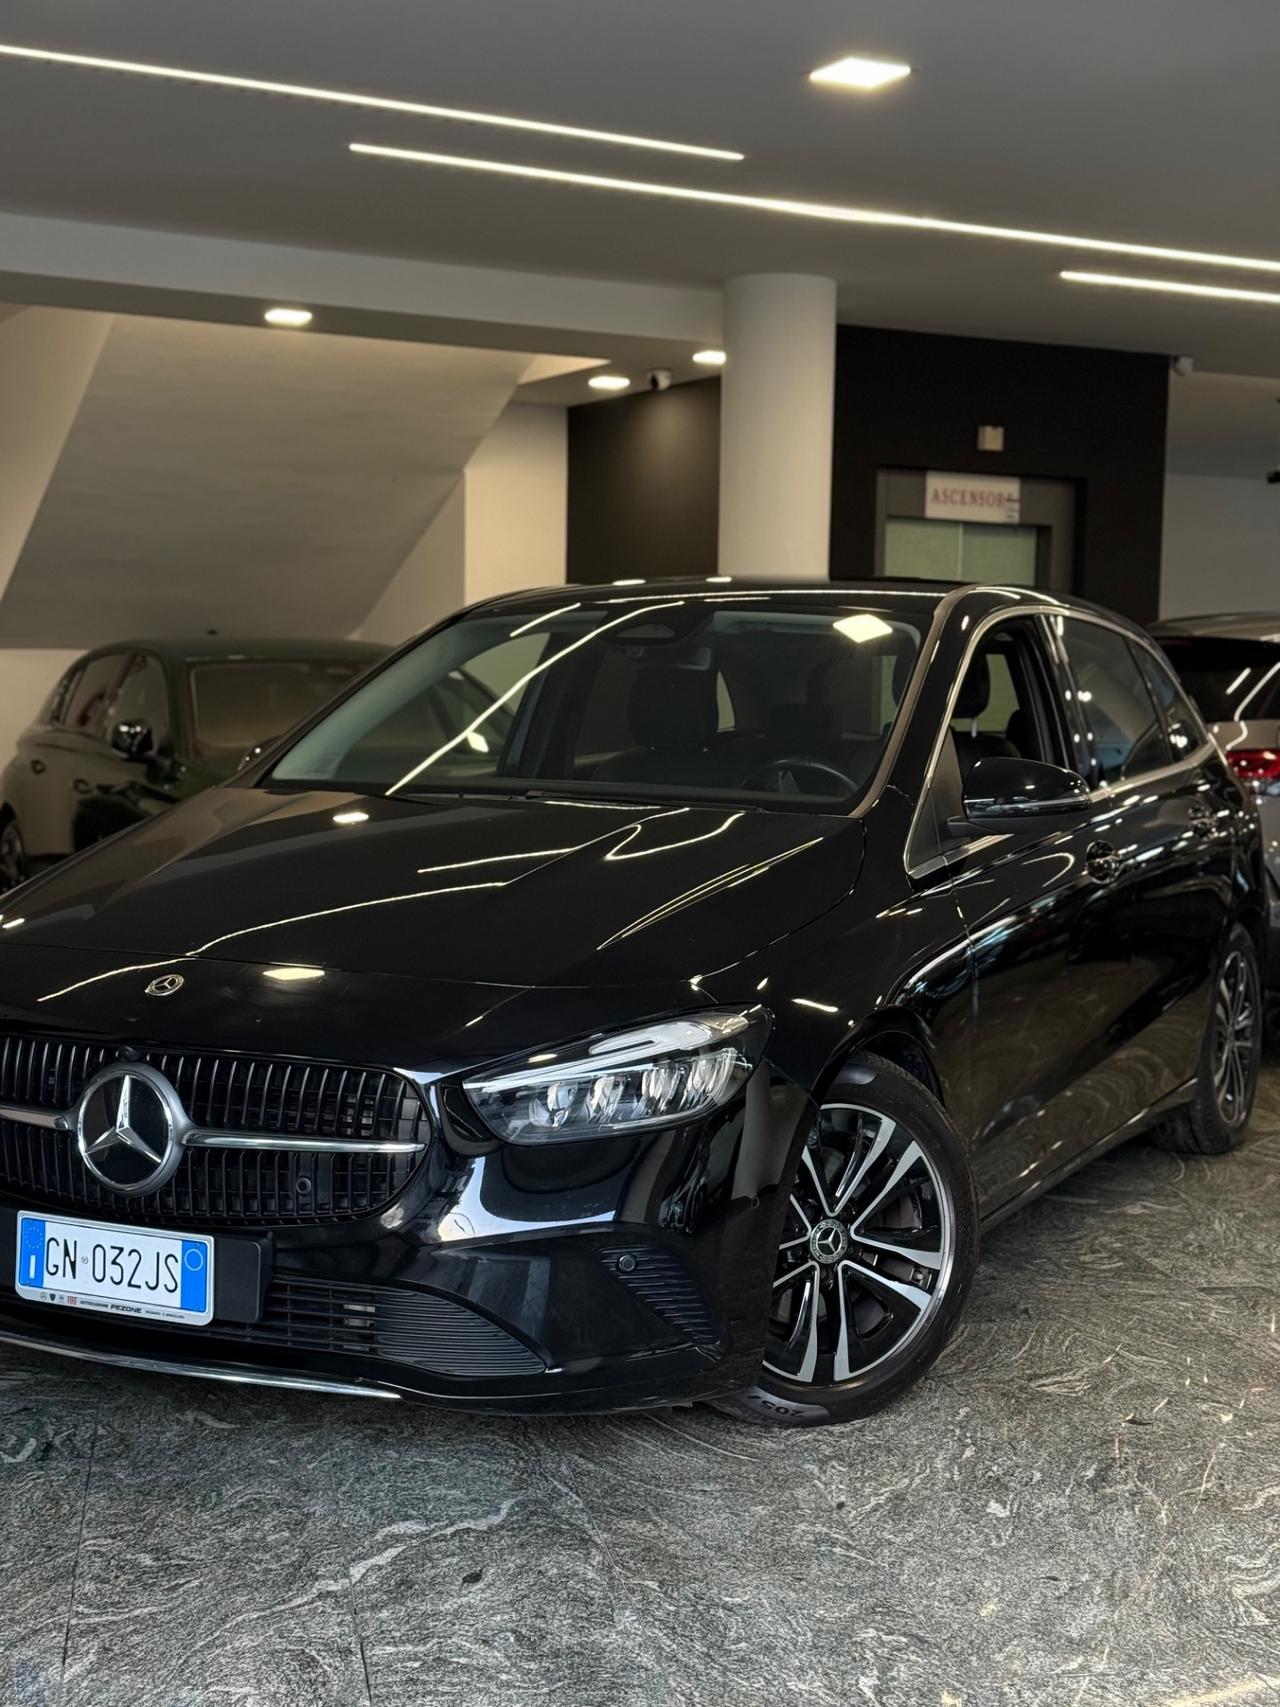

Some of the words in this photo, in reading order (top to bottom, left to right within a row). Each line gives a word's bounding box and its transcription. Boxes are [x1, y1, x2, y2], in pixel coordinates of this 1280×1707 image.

[45, 1236, 78, 1280] GN
[92, 1243, 179, 1294] 032JS
[110, 1304, 142, 1314] PEZONE
